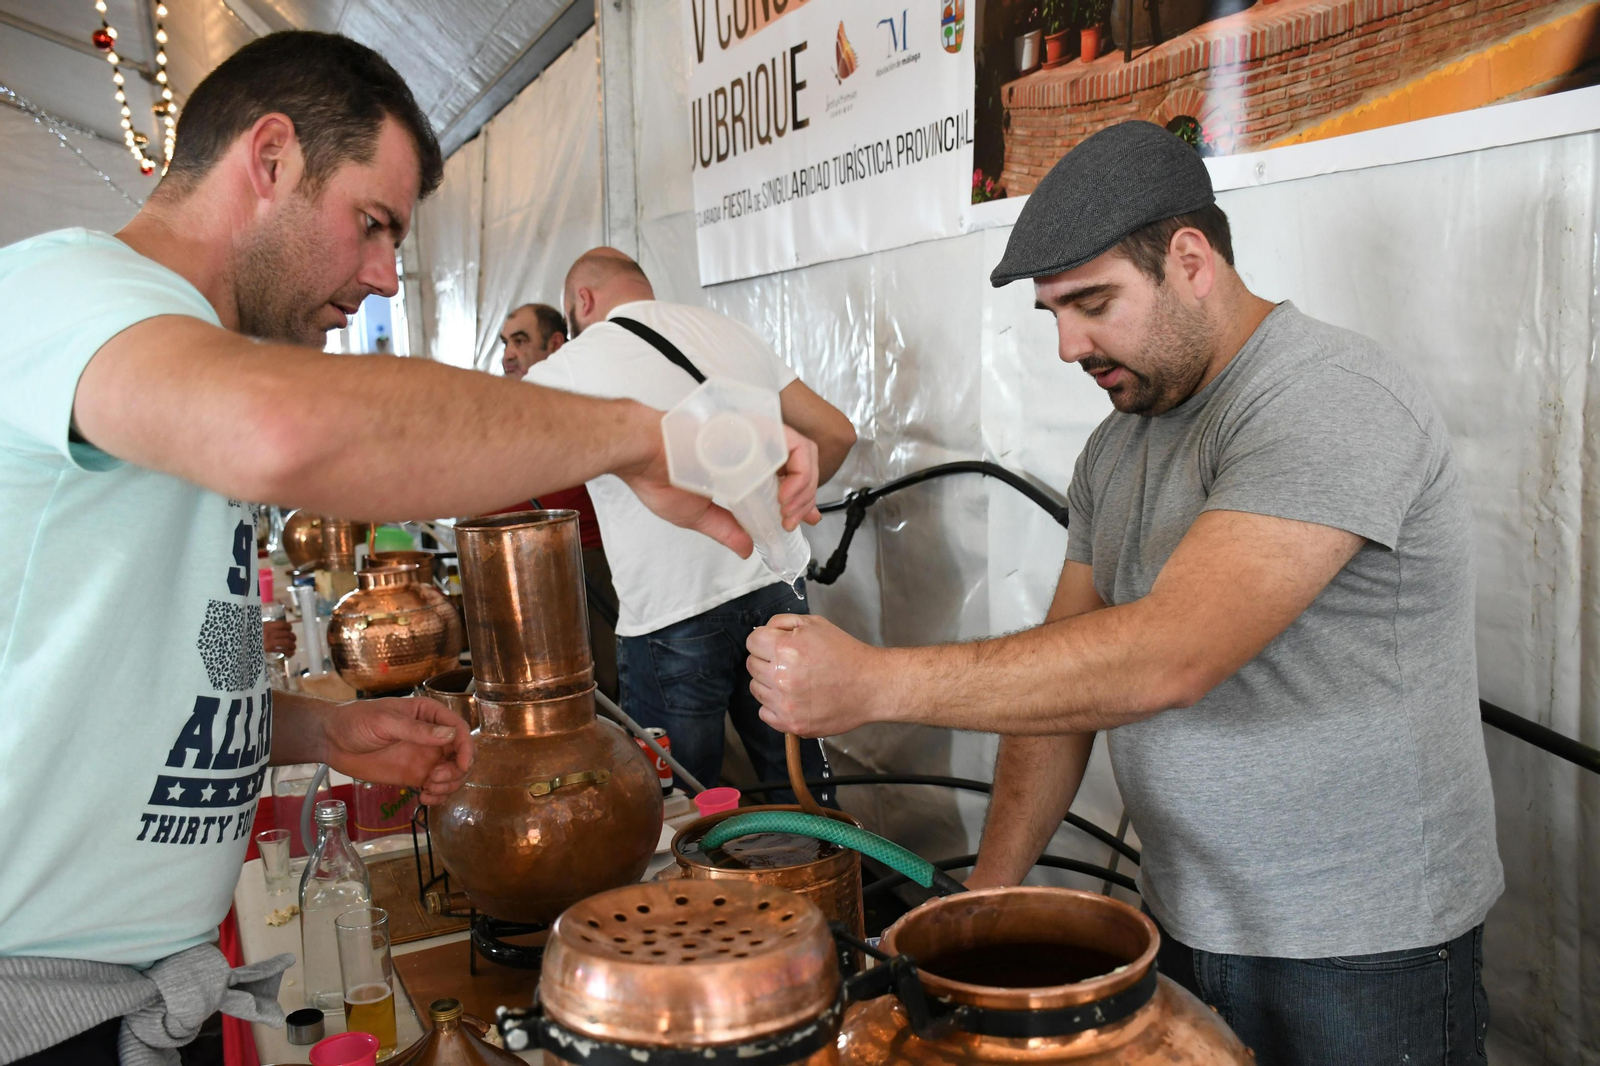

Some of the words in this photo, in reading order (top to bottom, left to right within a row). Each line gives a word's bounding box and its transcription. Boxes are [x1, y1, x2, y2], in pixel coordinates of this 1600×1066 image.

[692, 40, 809, 173] JUBRIQUE
[722, 188, 753, 220] FIESTA
[761, 160, 830, 209] SINGULARIDAD
[833, 139, 893, 187] TURÍSTICA
[896, 109, 973, 168] PROVINCIAL
[136, 813, 233, 845] THIRTY
